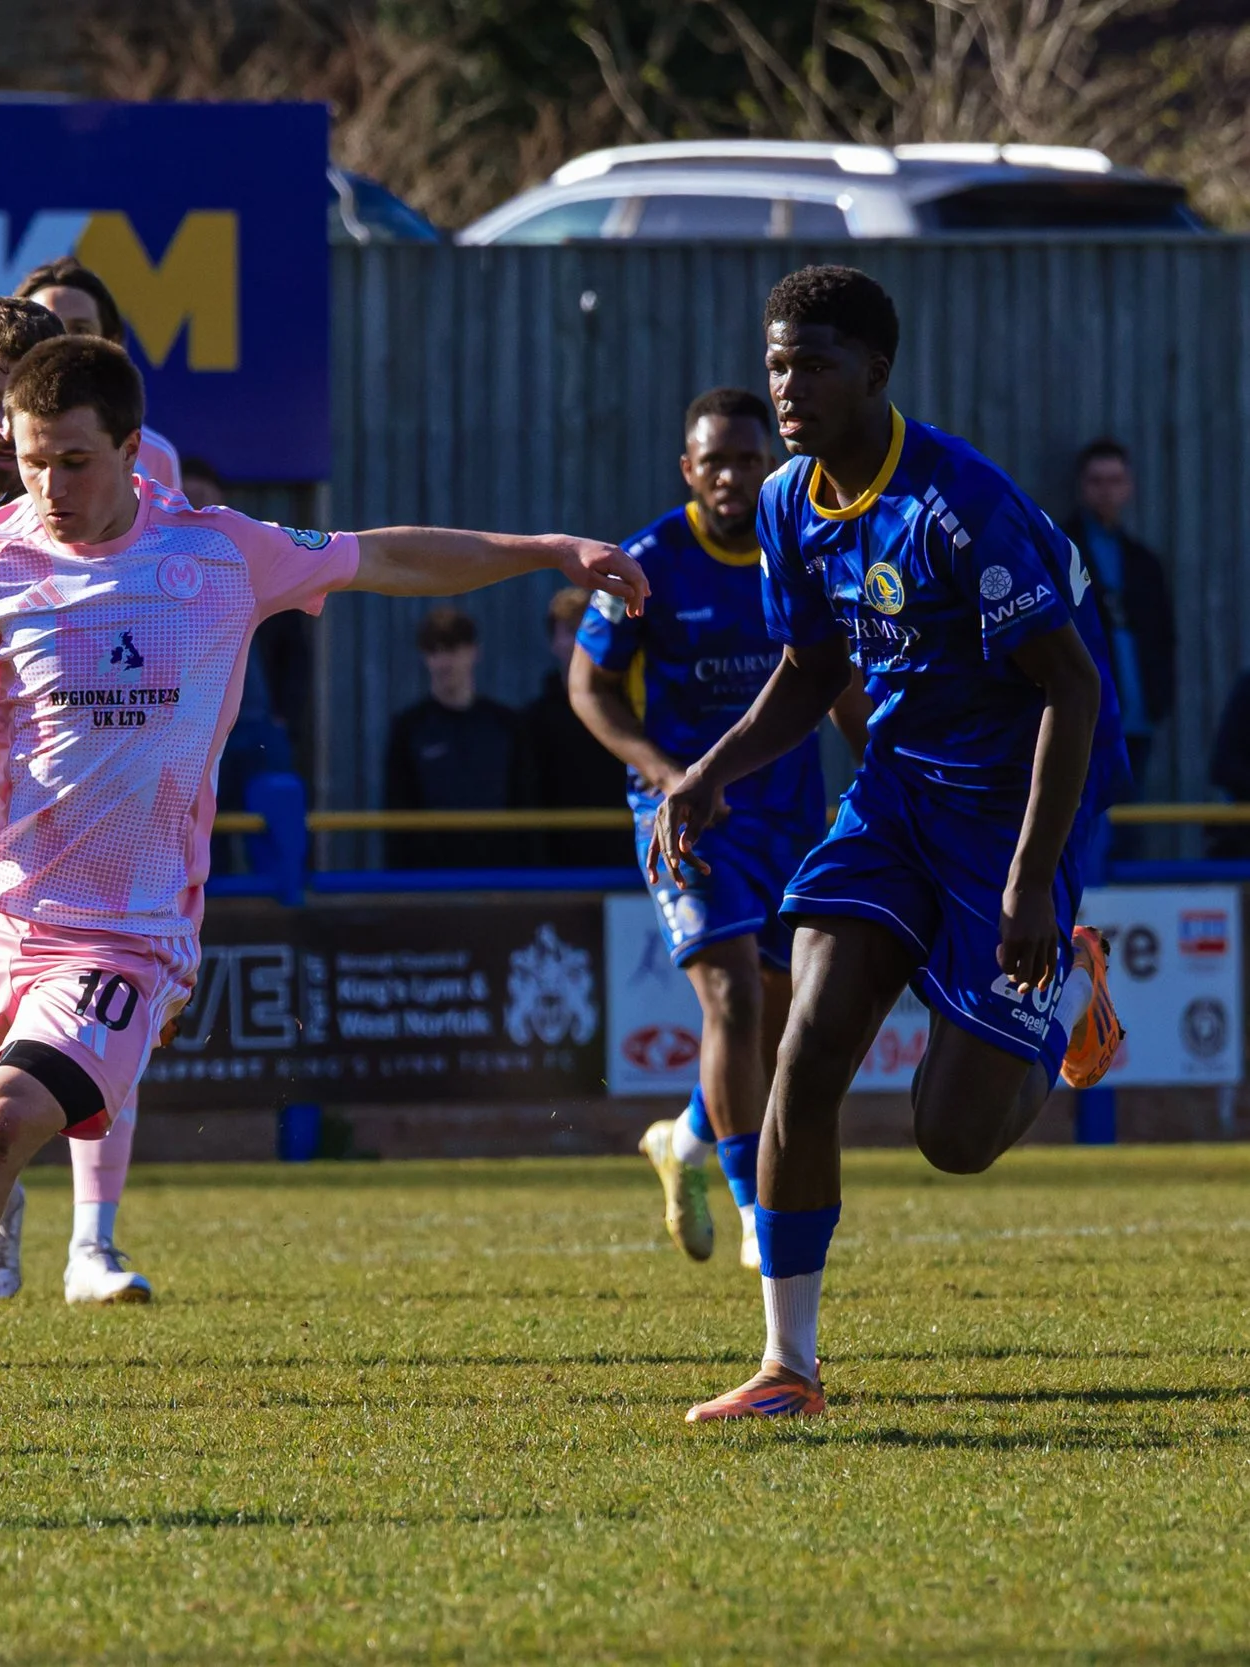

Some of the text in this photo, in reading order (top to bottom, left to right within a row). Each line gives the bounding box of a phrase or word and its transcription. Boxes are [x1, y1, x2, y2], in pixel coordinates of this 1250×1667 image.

[50, 689, 125, 706] REGIONAL
[93, 710, 146, 726] UK LTD
[75, 969, 139, 1031] 10
